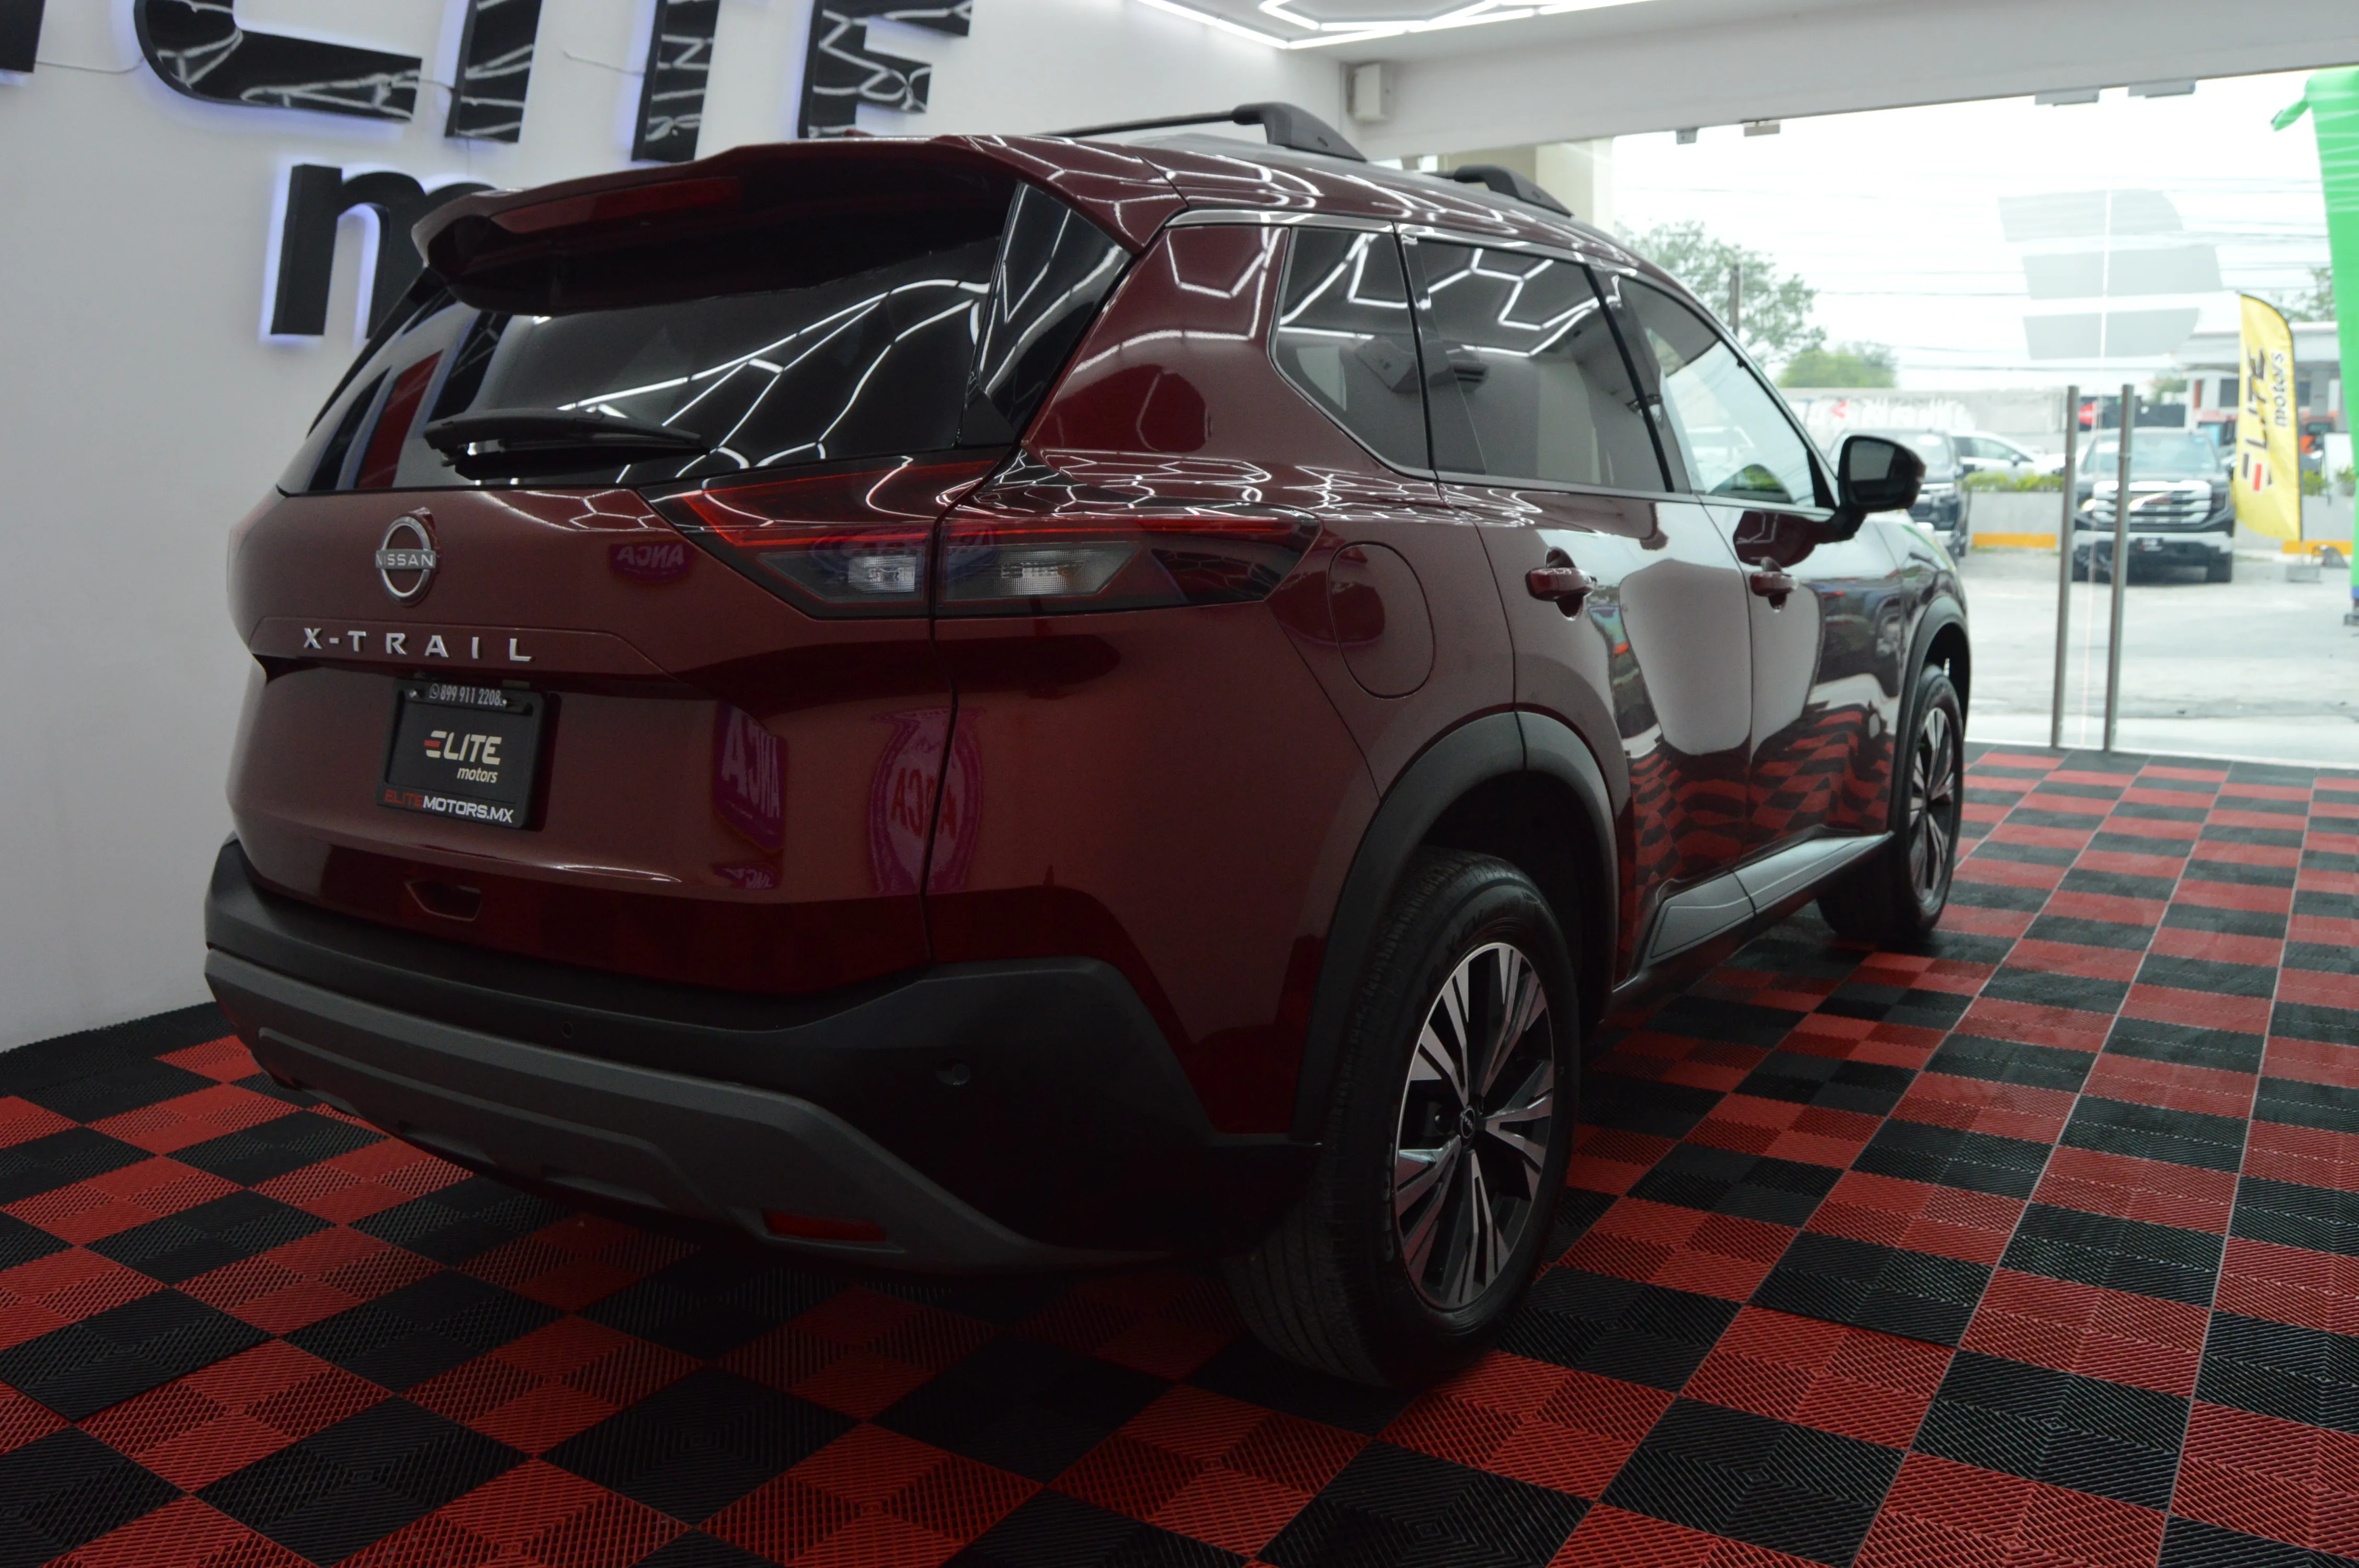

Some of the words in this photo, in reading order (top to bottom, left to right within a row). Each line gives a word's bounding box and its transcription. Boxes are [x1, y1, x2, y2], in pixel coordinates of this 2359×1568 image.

[376, 553, 433, 567] NISSAN
[303, 627, 532, 662] X-TRAIL
[440, 684, 457, 701] 899
[459, 686, 476, 704] 911
[424, 730, 502, 765] ELITE
[456, 767, 498, 783] motors
